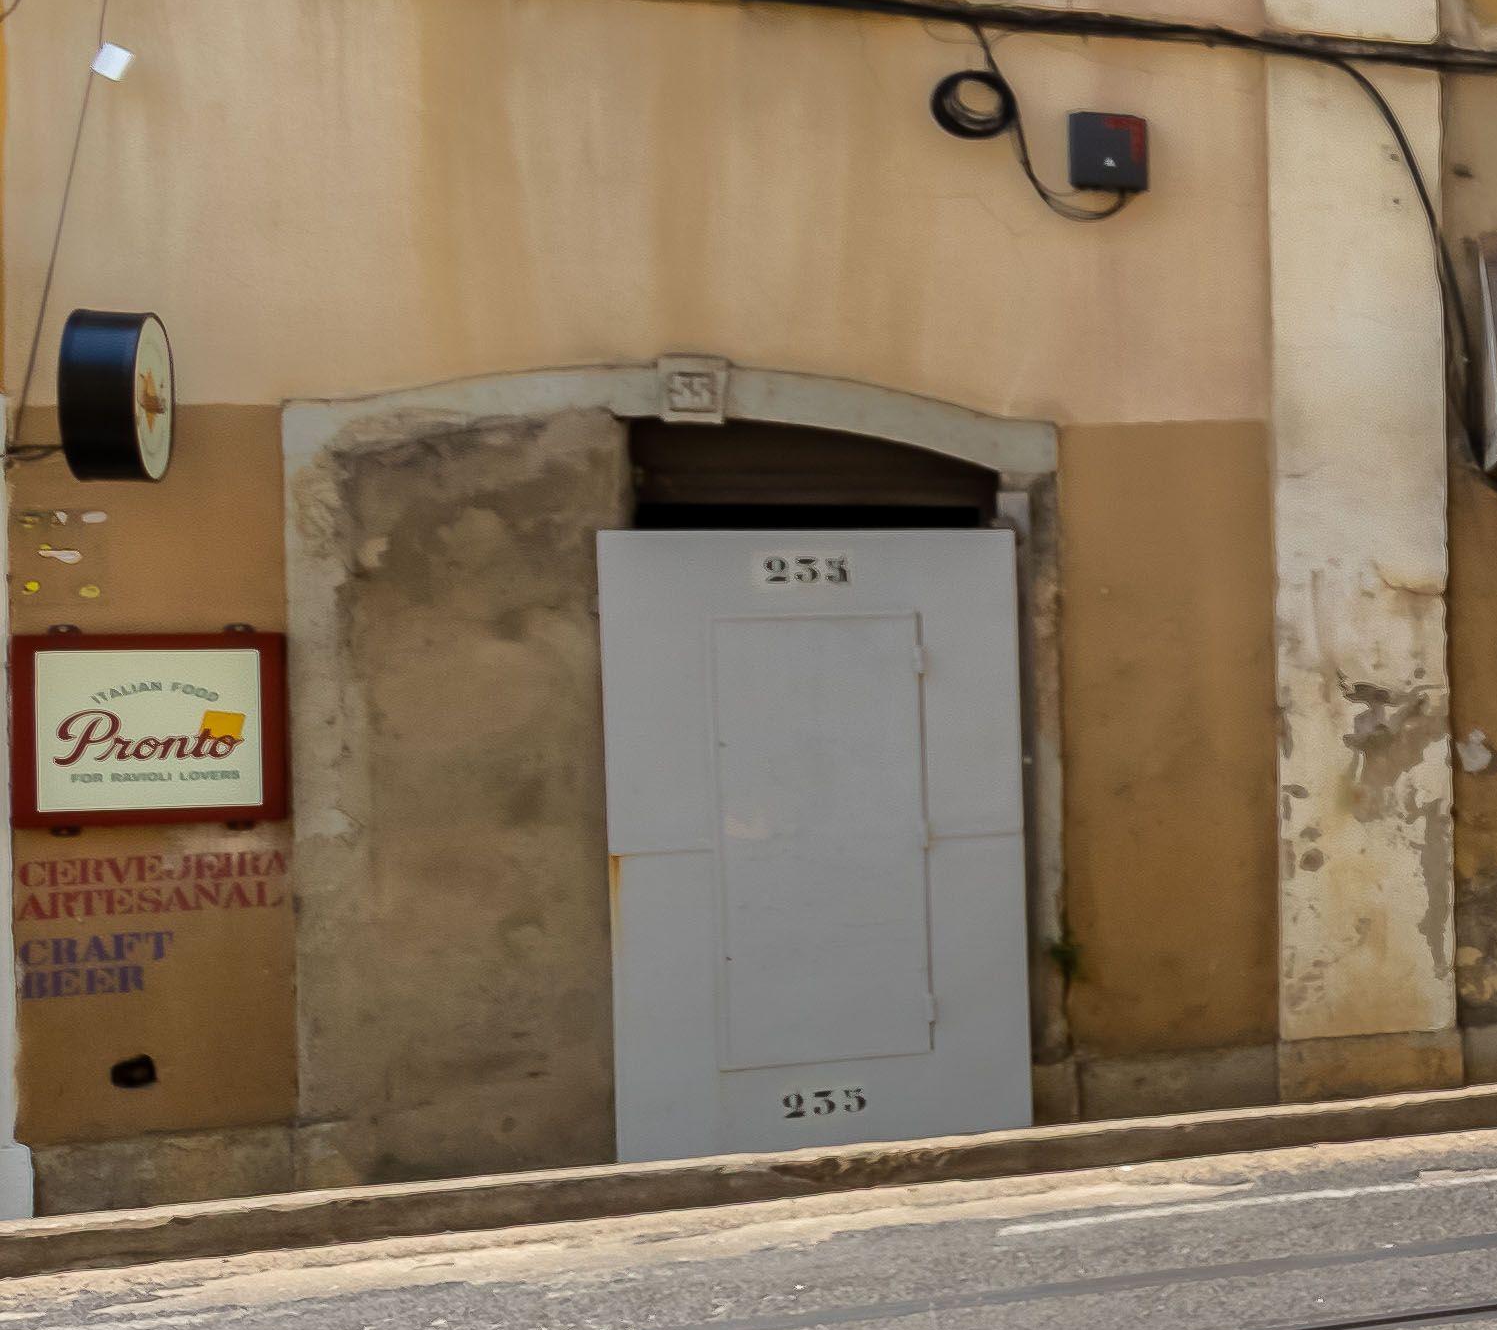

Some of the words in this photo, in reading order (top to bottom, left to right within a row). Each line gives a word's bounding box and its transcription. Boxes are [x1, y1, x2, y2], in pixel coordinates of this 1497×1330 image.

[91, 681, 162, 704] ITALIAN
[171, 682, 219, 702] FOOD
[53, 708, 246, 766] Pronto
[70, 772, 103, 783] FOR
[110, 771, 172, 783] RAVIOLI
[179, 769, 240, 782] LOVERS
[18, 850, 289, 887] CERVEJEIRA
[17, 881, 285, 921] ARTESANAL
[19, 931, 174, 966] CRAFT
[22, 966, 145, 999] BEER
